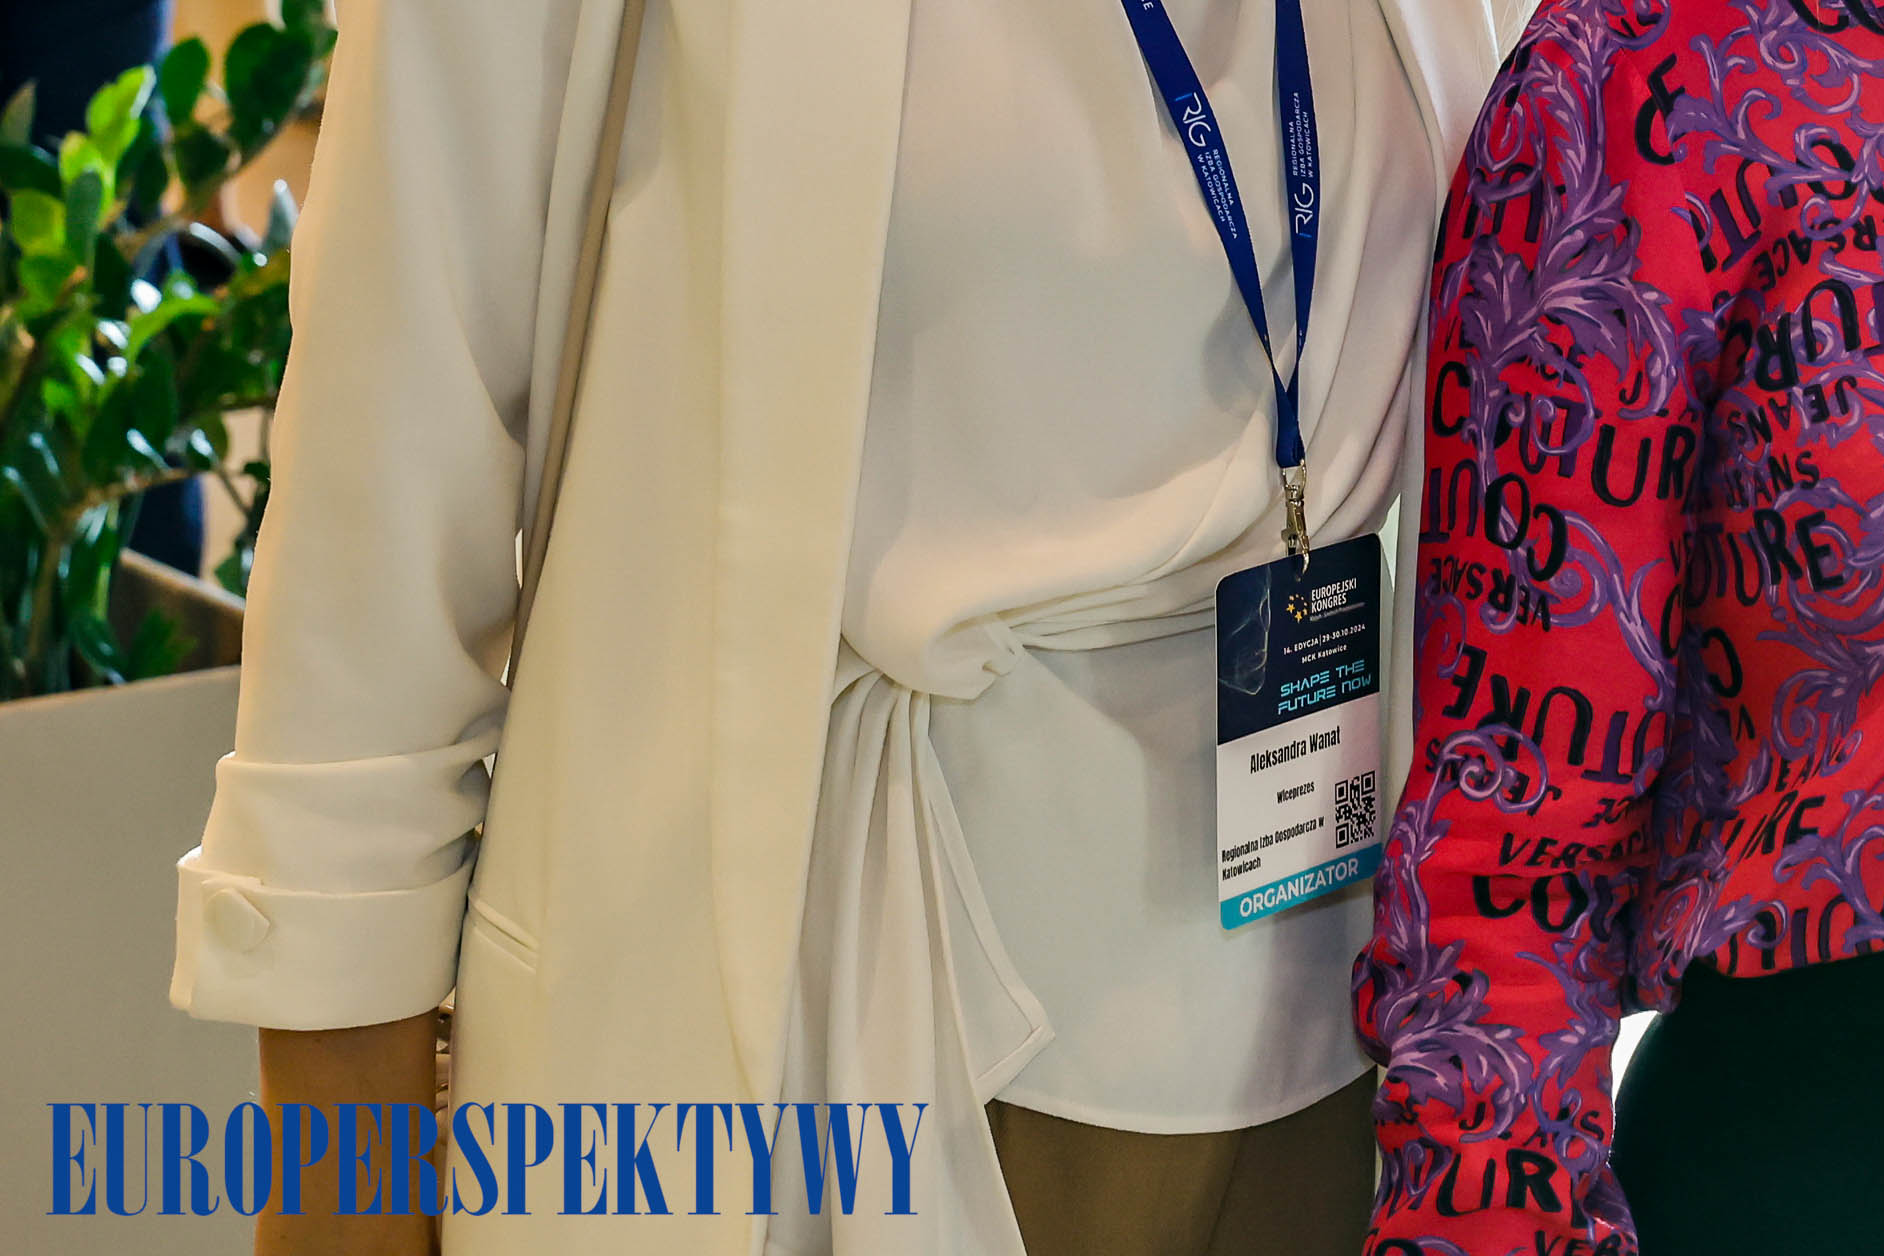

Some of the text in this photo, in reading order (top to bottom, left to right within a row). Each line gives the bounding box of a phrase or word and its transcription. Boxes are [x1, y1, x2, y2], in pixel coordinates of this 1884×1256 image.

[1175, 91, 1212, 147] RIG
[1293, 92, 1307, 177] IZBA GOSPODARCZA
[1302, 111, 1313, 168] KATOWICACH
[1289, 121, 1299, 176] REGIONALNA
[1201, 165, 1226, 222] KATOWICACH
[1205, 151, 1238, 239] IZBA GOSPODARCZA
[1212, 148, 1235, 205] REGIONALNA
[1294, 182, 1314, 238] RIG
[1311, 577, 1357, 602] EUROPEJSKI
[1311, 592, 1347, 614] KONGRES
[1283, 646, 1293, 656] 14.
[1294, 637, 1319, 652] EDYCJA
[1301, 644, 1348, 664] MCK Katowice
[1278, 685, 1337, 716] FUTURE
[1280, 659, 1365, 697] SHAPE THE
[1250, 725, 1342, 775] Aleksandra Wanat
[1276, 780, 1315, 805] Wiceprezes
[1221, 838, 1259, 864] Regionalna
[1259, 833, 1274, 849] Izba
[1274, 821, 1317, 846] Gospodarcza
[1222, 856, 1262, 881] Katowicach
[1239, 857, 1359, 918] ORGANIZATOR
